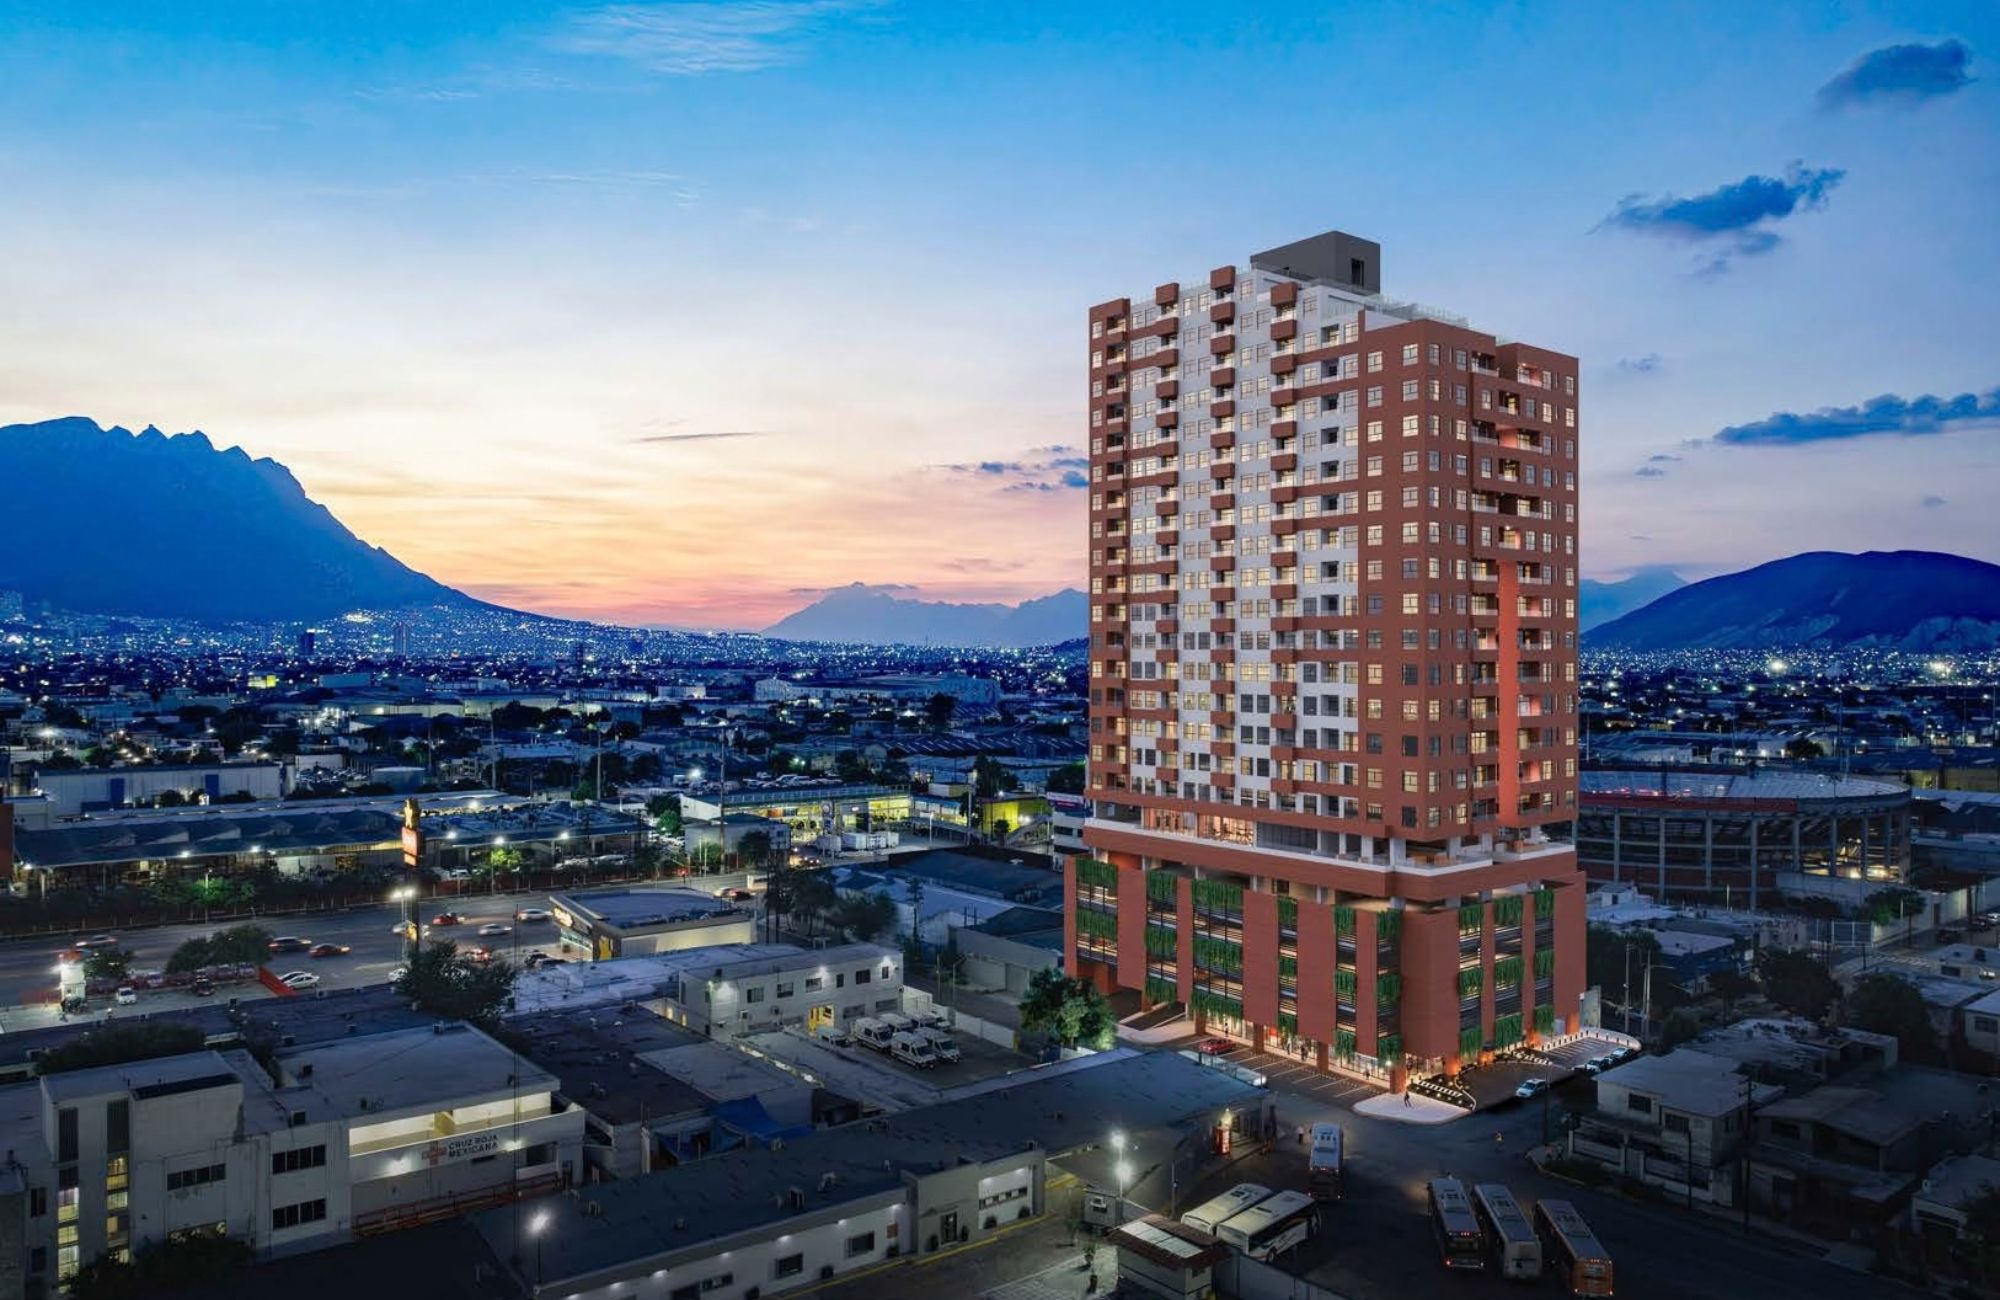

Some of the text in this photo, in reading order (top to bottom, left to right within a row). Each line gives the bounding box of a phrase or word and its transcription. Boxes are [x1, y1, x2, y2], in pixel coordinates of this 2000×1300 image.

[448, 1134, 498, 1150] CRUZ ROJA
[448, 1142, 498, 1157] MEXICANA
